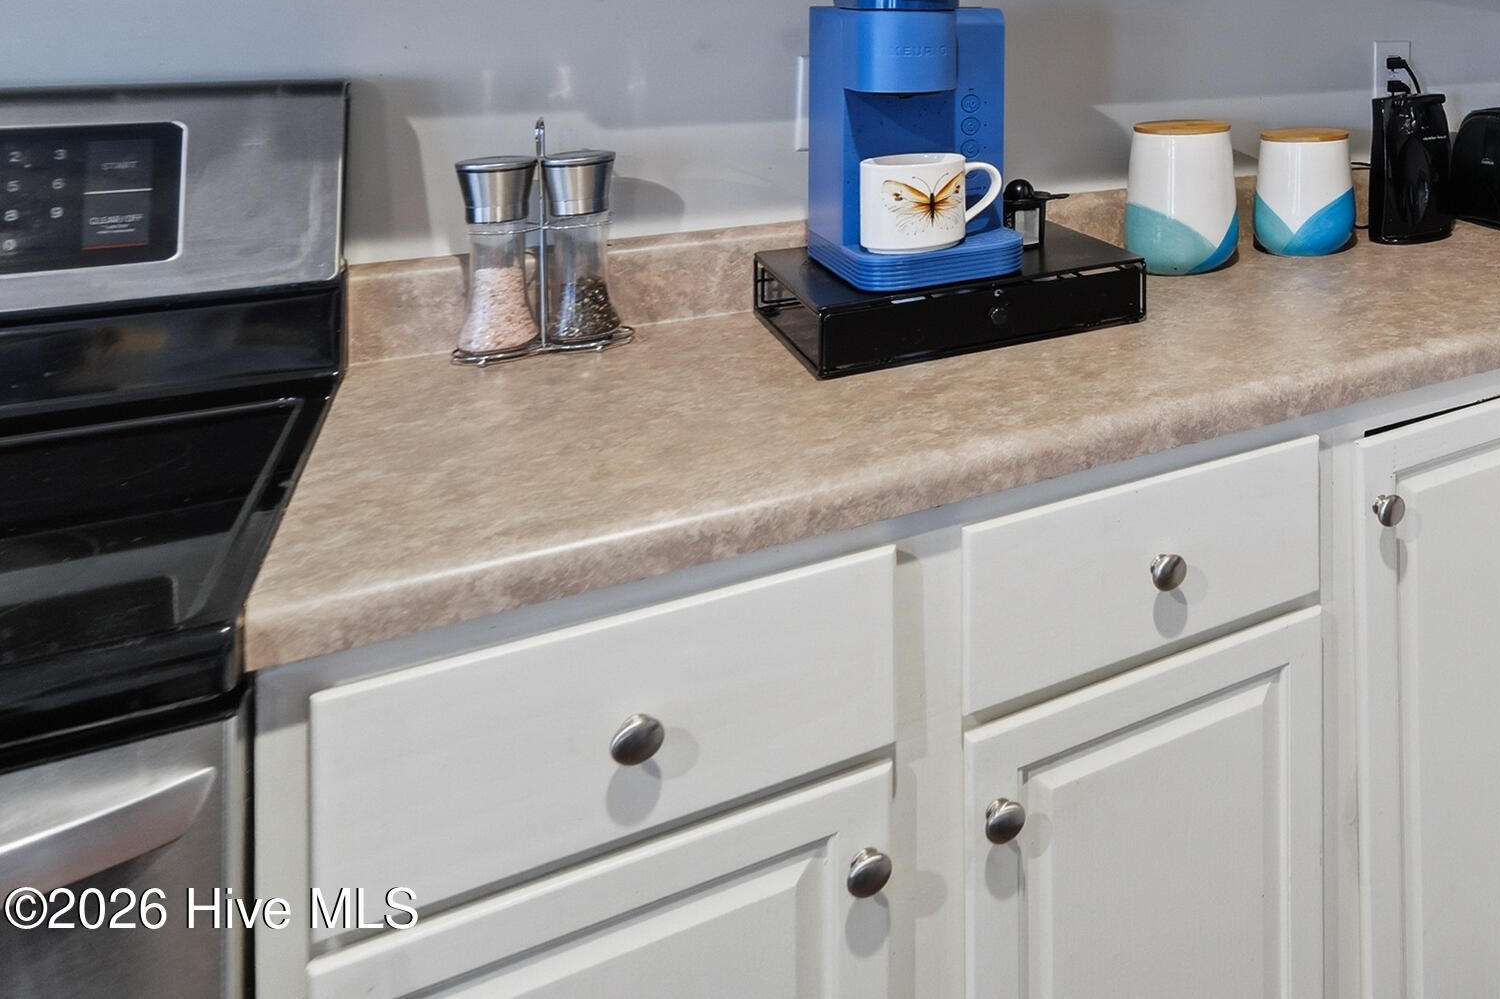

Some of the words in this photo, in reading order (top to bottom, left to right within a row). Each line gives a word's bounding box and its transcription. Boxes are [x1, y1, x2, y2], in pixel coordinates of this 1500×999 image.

[9, 151, 23, 163] 2
[53, 149, 66, 160] 3
[6, 180, 21, 192] 5
[51, 178, 66, 190] 6
[4, 210, 18, 221] 8
[50, 206, 64, 219] 9
